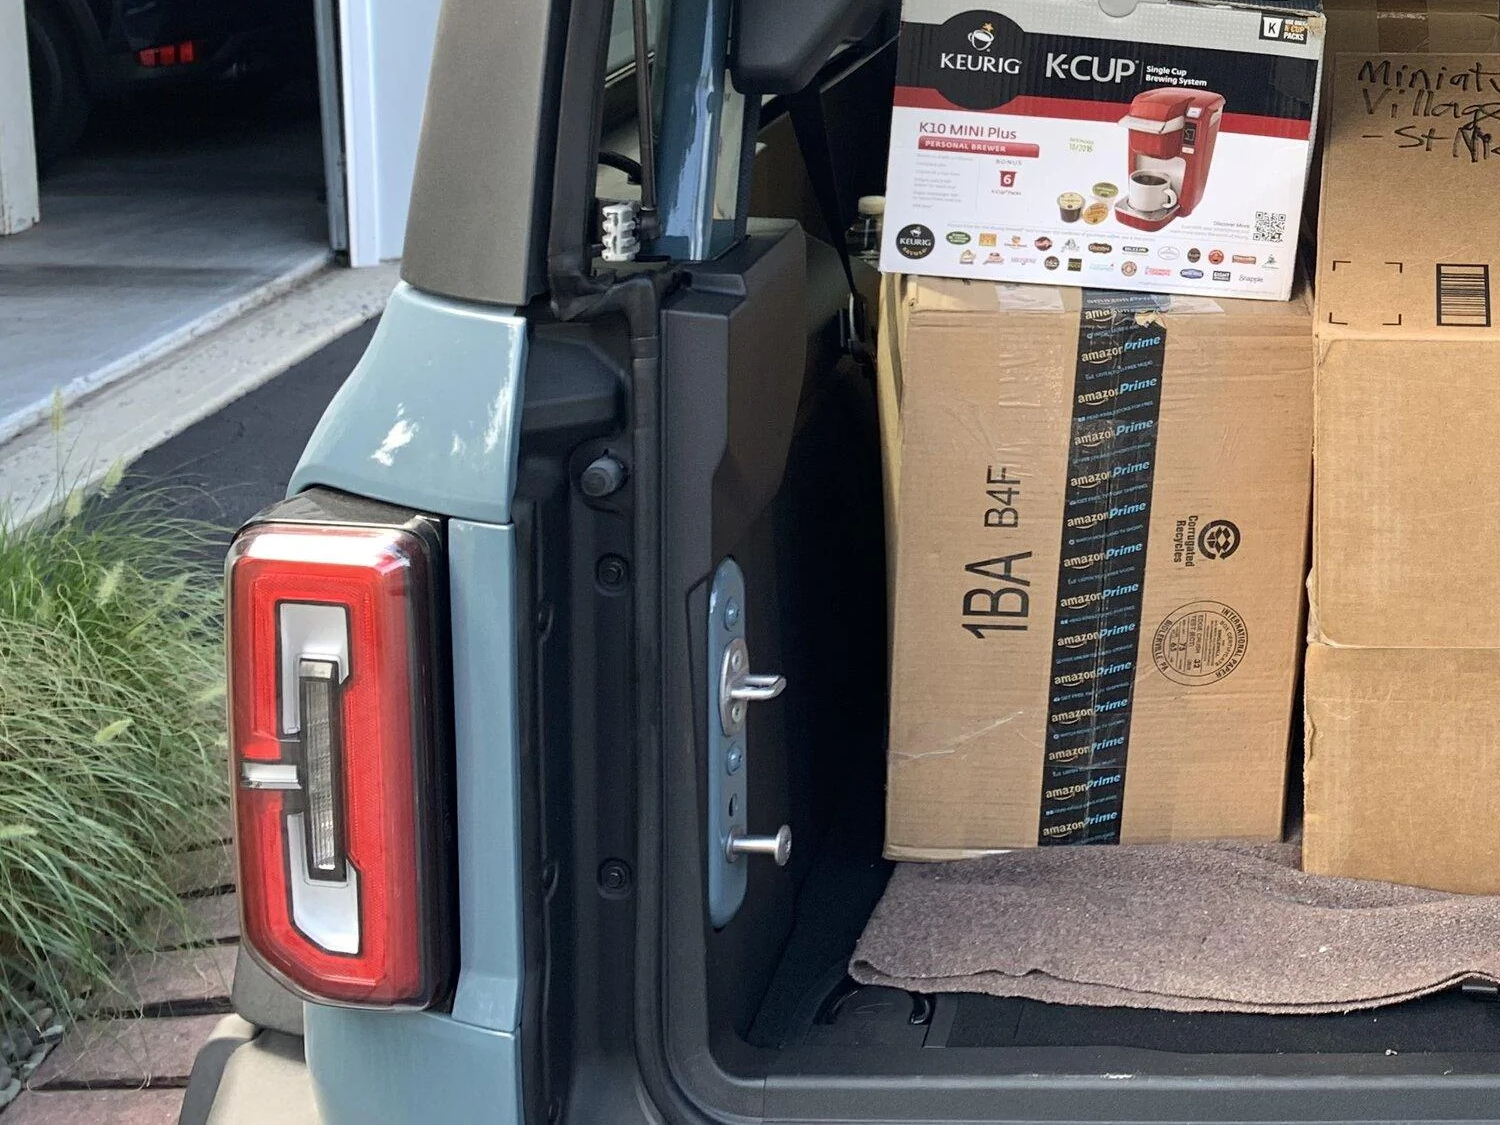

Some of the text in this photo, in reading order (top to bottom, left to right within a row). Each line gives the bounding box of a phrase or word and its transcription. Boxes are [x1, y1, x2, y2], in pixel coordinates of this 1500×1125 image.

[1268, 22, 1276, 34] K
[940, 52, 1021, 75] KEURIG
[1146, 65, 1187, 77] Single Cup
[1145, 74, 1207, 87] Brewing System
[919, 122, 1017, 140] K10 MINI Plus
[925, 140, 1006, 153] PERSONAL BREWER
[995, 158, 1023, 166] BONUS
[1003, 174, 1012, 184] 6
[899, 237, 932, 247] KEURIG
[1074, 419, 1153, 446] amazoPrime
[1173, 520, 1187, 563] Recycles
[1184, 515, 1199, 567] Corrugated
[961, 465, 1033, 639] 1BA B4F
[1215, 607, 1246, 678] INTERNATIONAL PAPER
[1160, 661, 1169, 672] PA
[1193, 658, 1200, 669] 32
